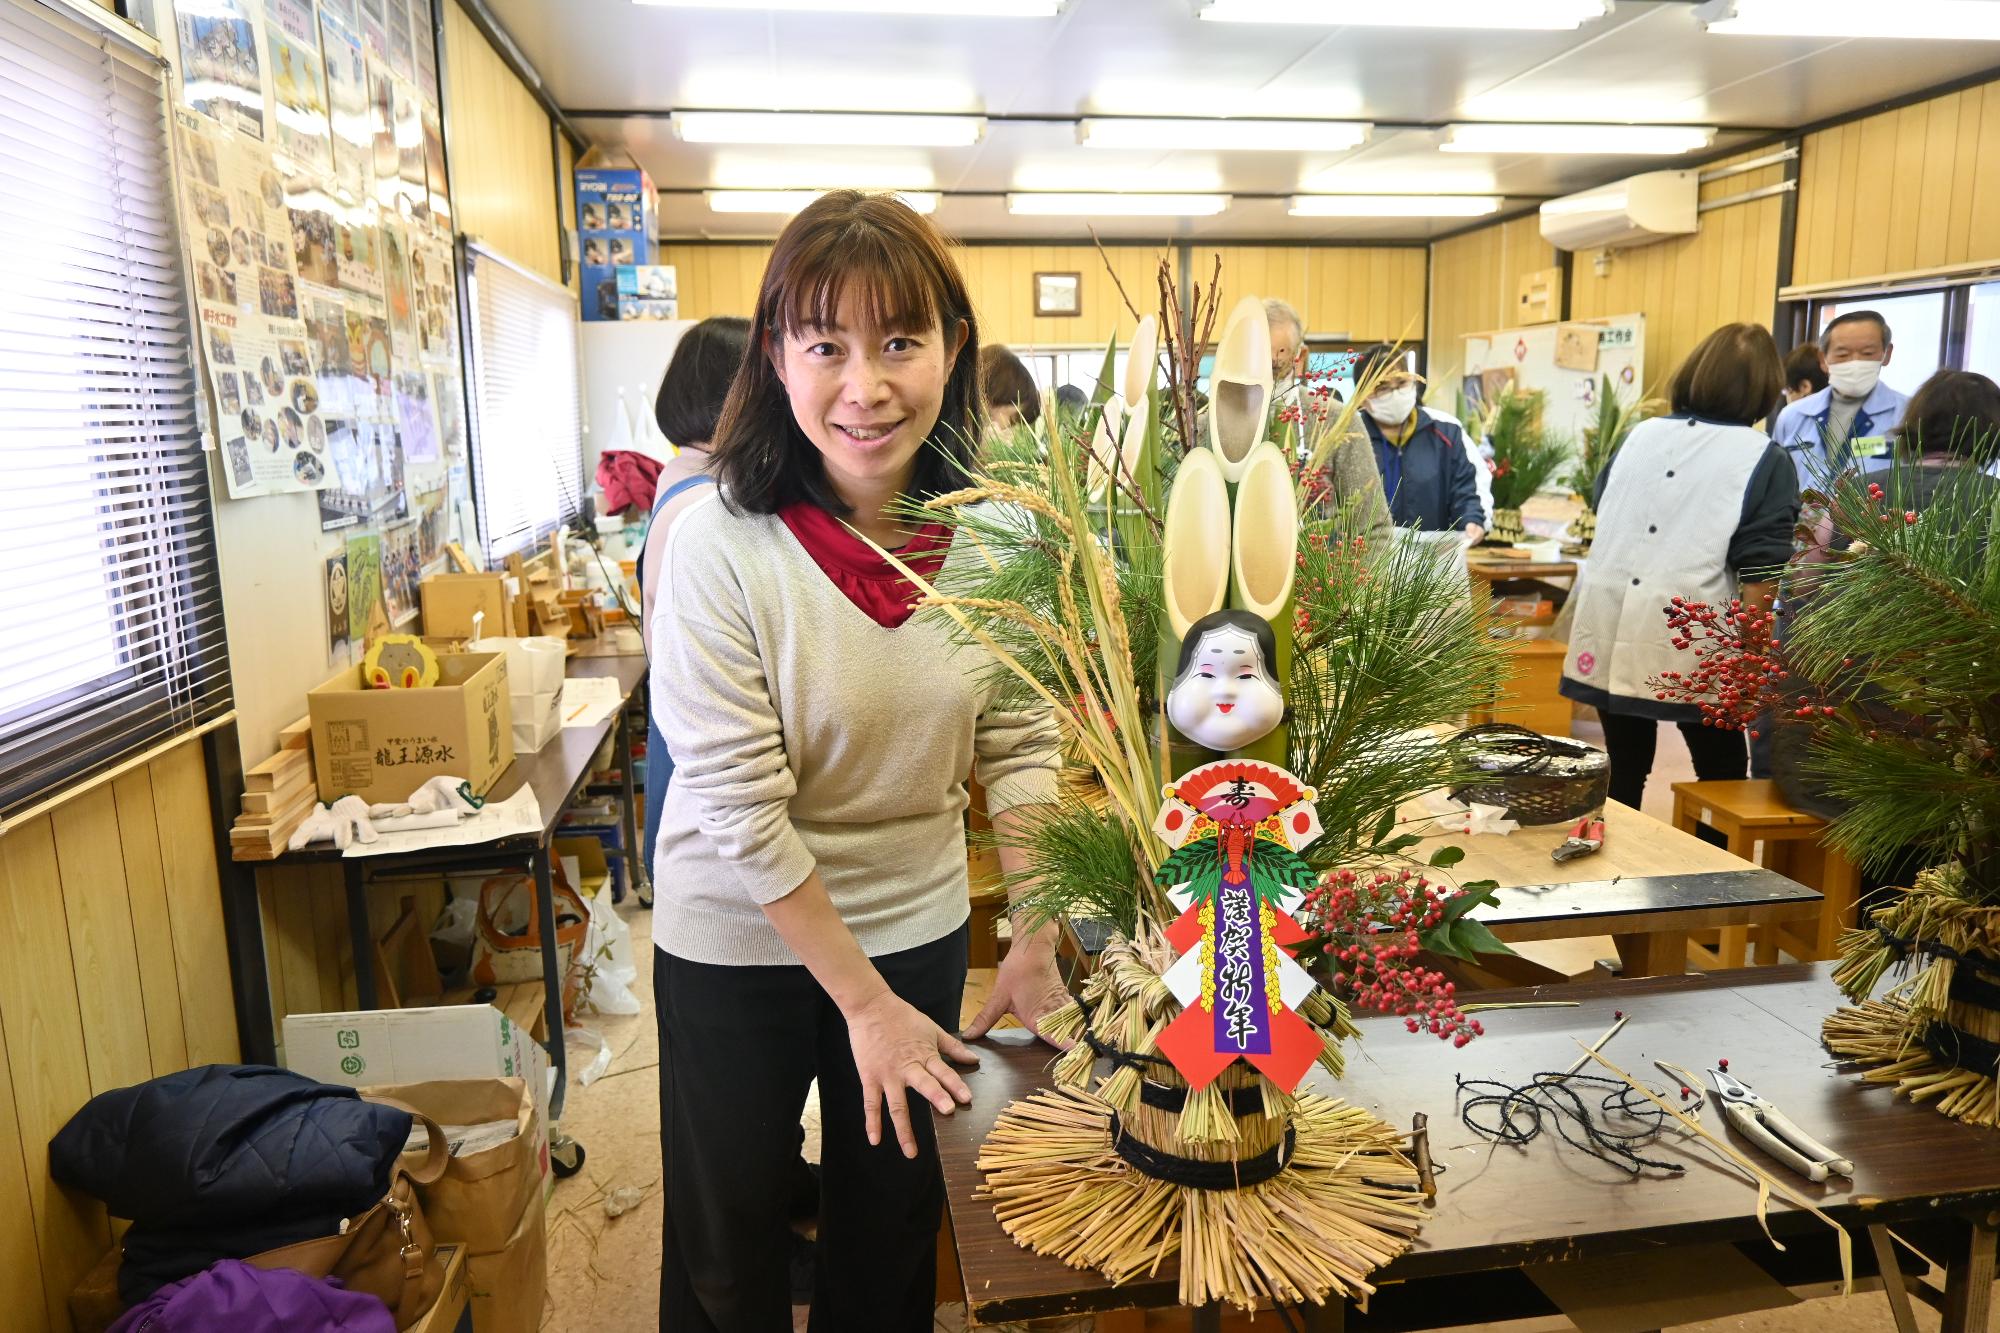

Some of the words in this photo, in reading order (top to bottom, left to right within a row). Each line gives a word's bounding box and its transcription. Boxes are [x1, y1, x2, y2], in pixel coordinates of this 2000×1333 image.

[580, 182, 608, 192] RYOBI
[374, 744, 455, 767] 龍王源水
[1221, 776, 1256, 811] 寿
[1218, 888, 1258, 1050] 謹賀新年
